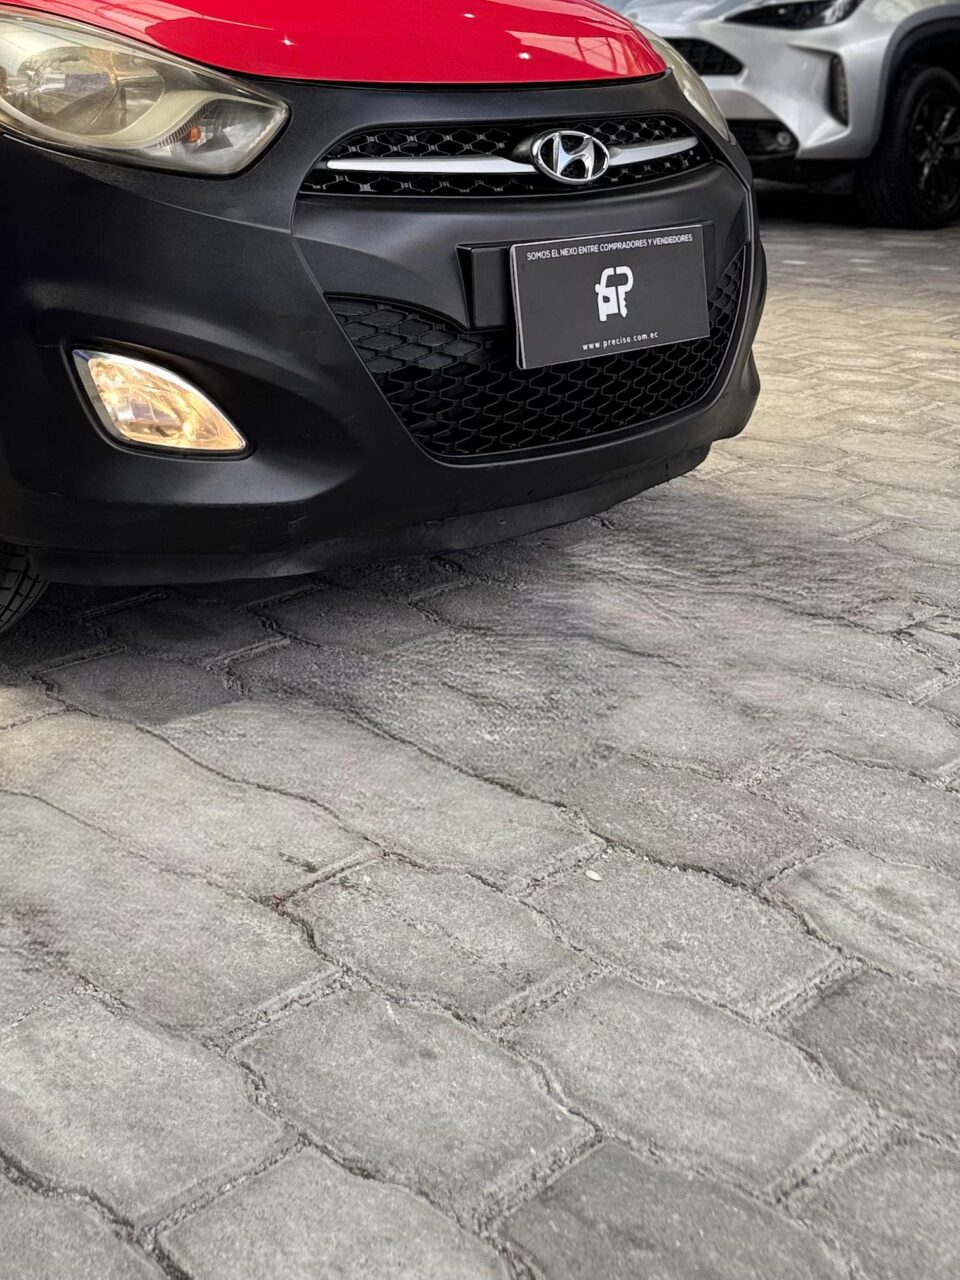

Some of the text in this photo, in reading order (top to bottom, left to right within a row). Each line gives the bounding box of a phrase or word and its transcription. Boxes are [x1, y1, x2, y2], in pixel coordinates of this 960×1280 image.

[526, 233, 693, 261] SOMOS EL NEXO ENTRE COMPRADORES Y VENDEDORES
